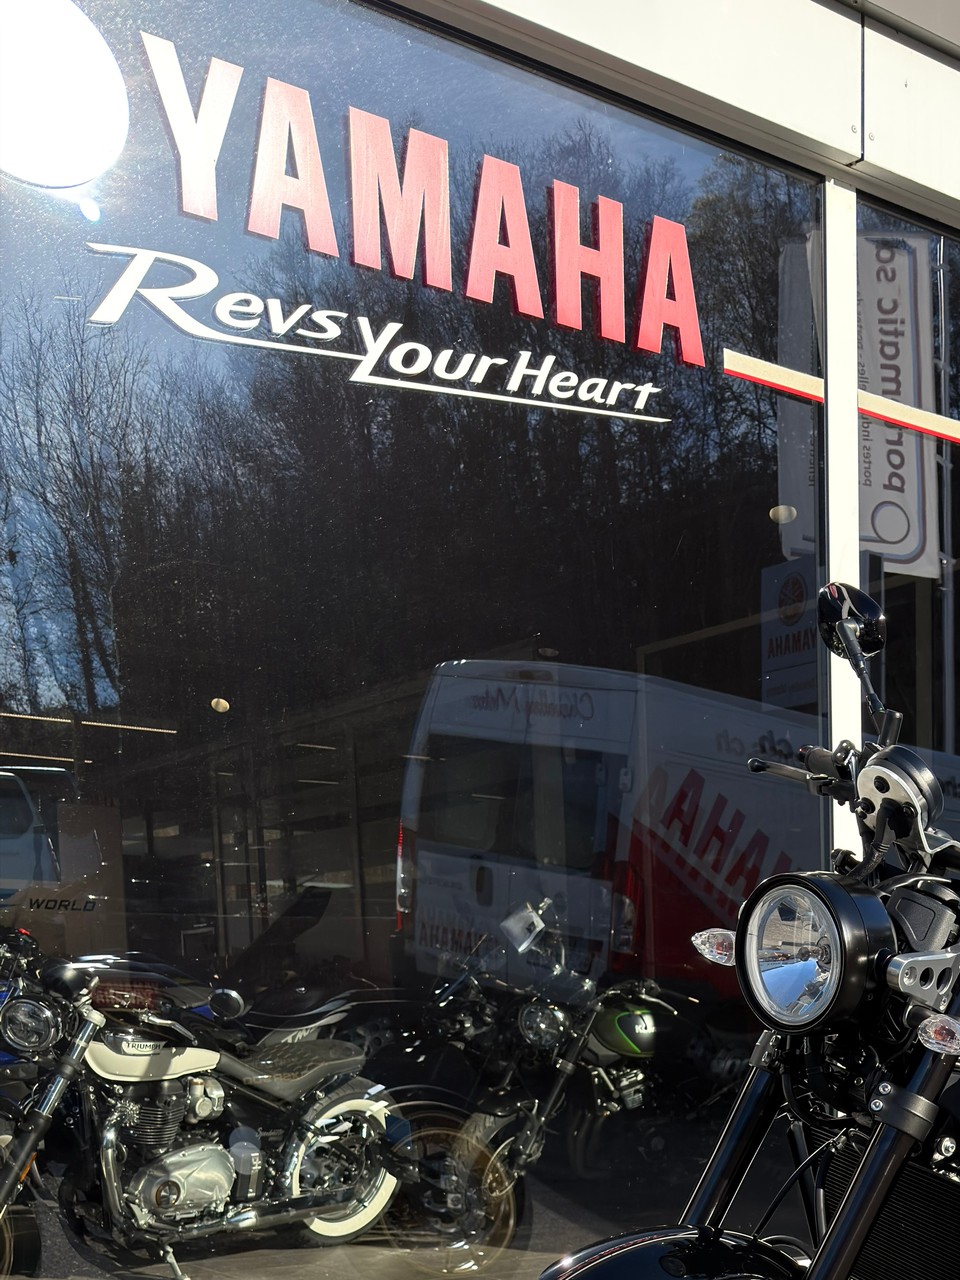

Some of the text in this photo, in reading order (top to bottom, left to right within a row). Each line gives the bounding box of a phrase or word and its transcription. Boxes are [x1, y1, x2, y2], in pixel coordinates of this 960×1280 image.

[140, 30, 706, 368] YAMAHA
[86, 242, 662, 411] Revs Your Heart
[29, 898, 97, 912] WORLD
[126, 1041, 161, 1050] TRIUMPH
